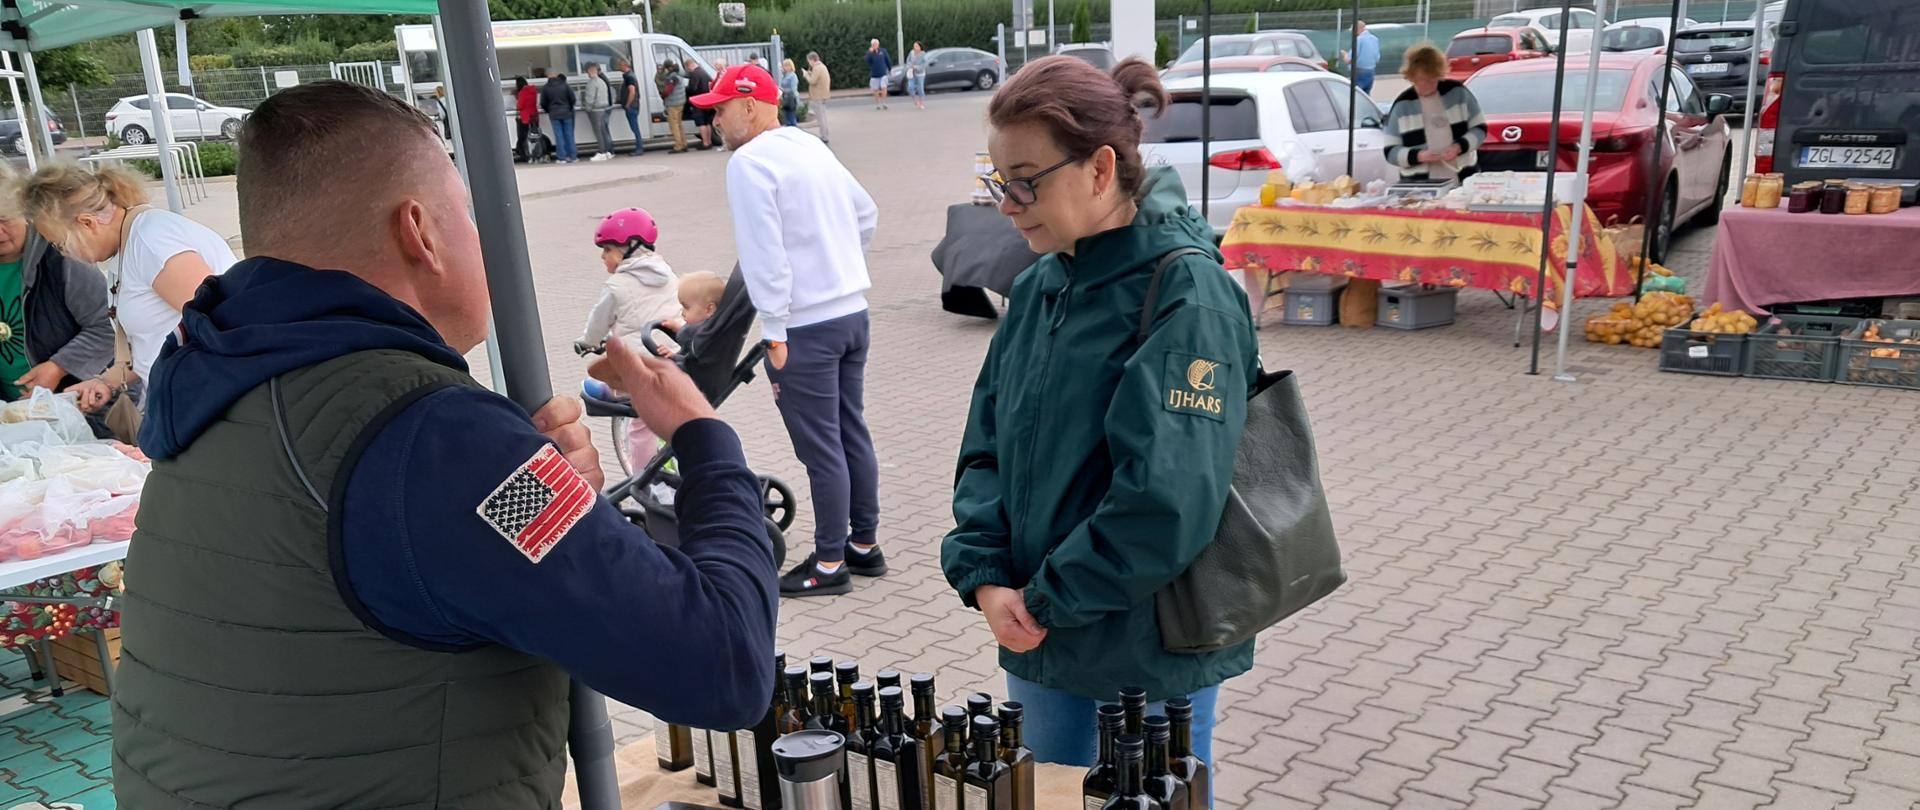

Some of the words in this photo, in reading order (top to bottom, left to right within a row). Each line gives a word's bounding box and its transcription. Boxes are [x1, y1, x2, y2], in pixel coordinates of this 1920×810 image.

[1809, 148, 1837, 163] ZGL
[1843, 148, 1893, 164] 92542
[1169, 389, 1222, 413] IJHARS
